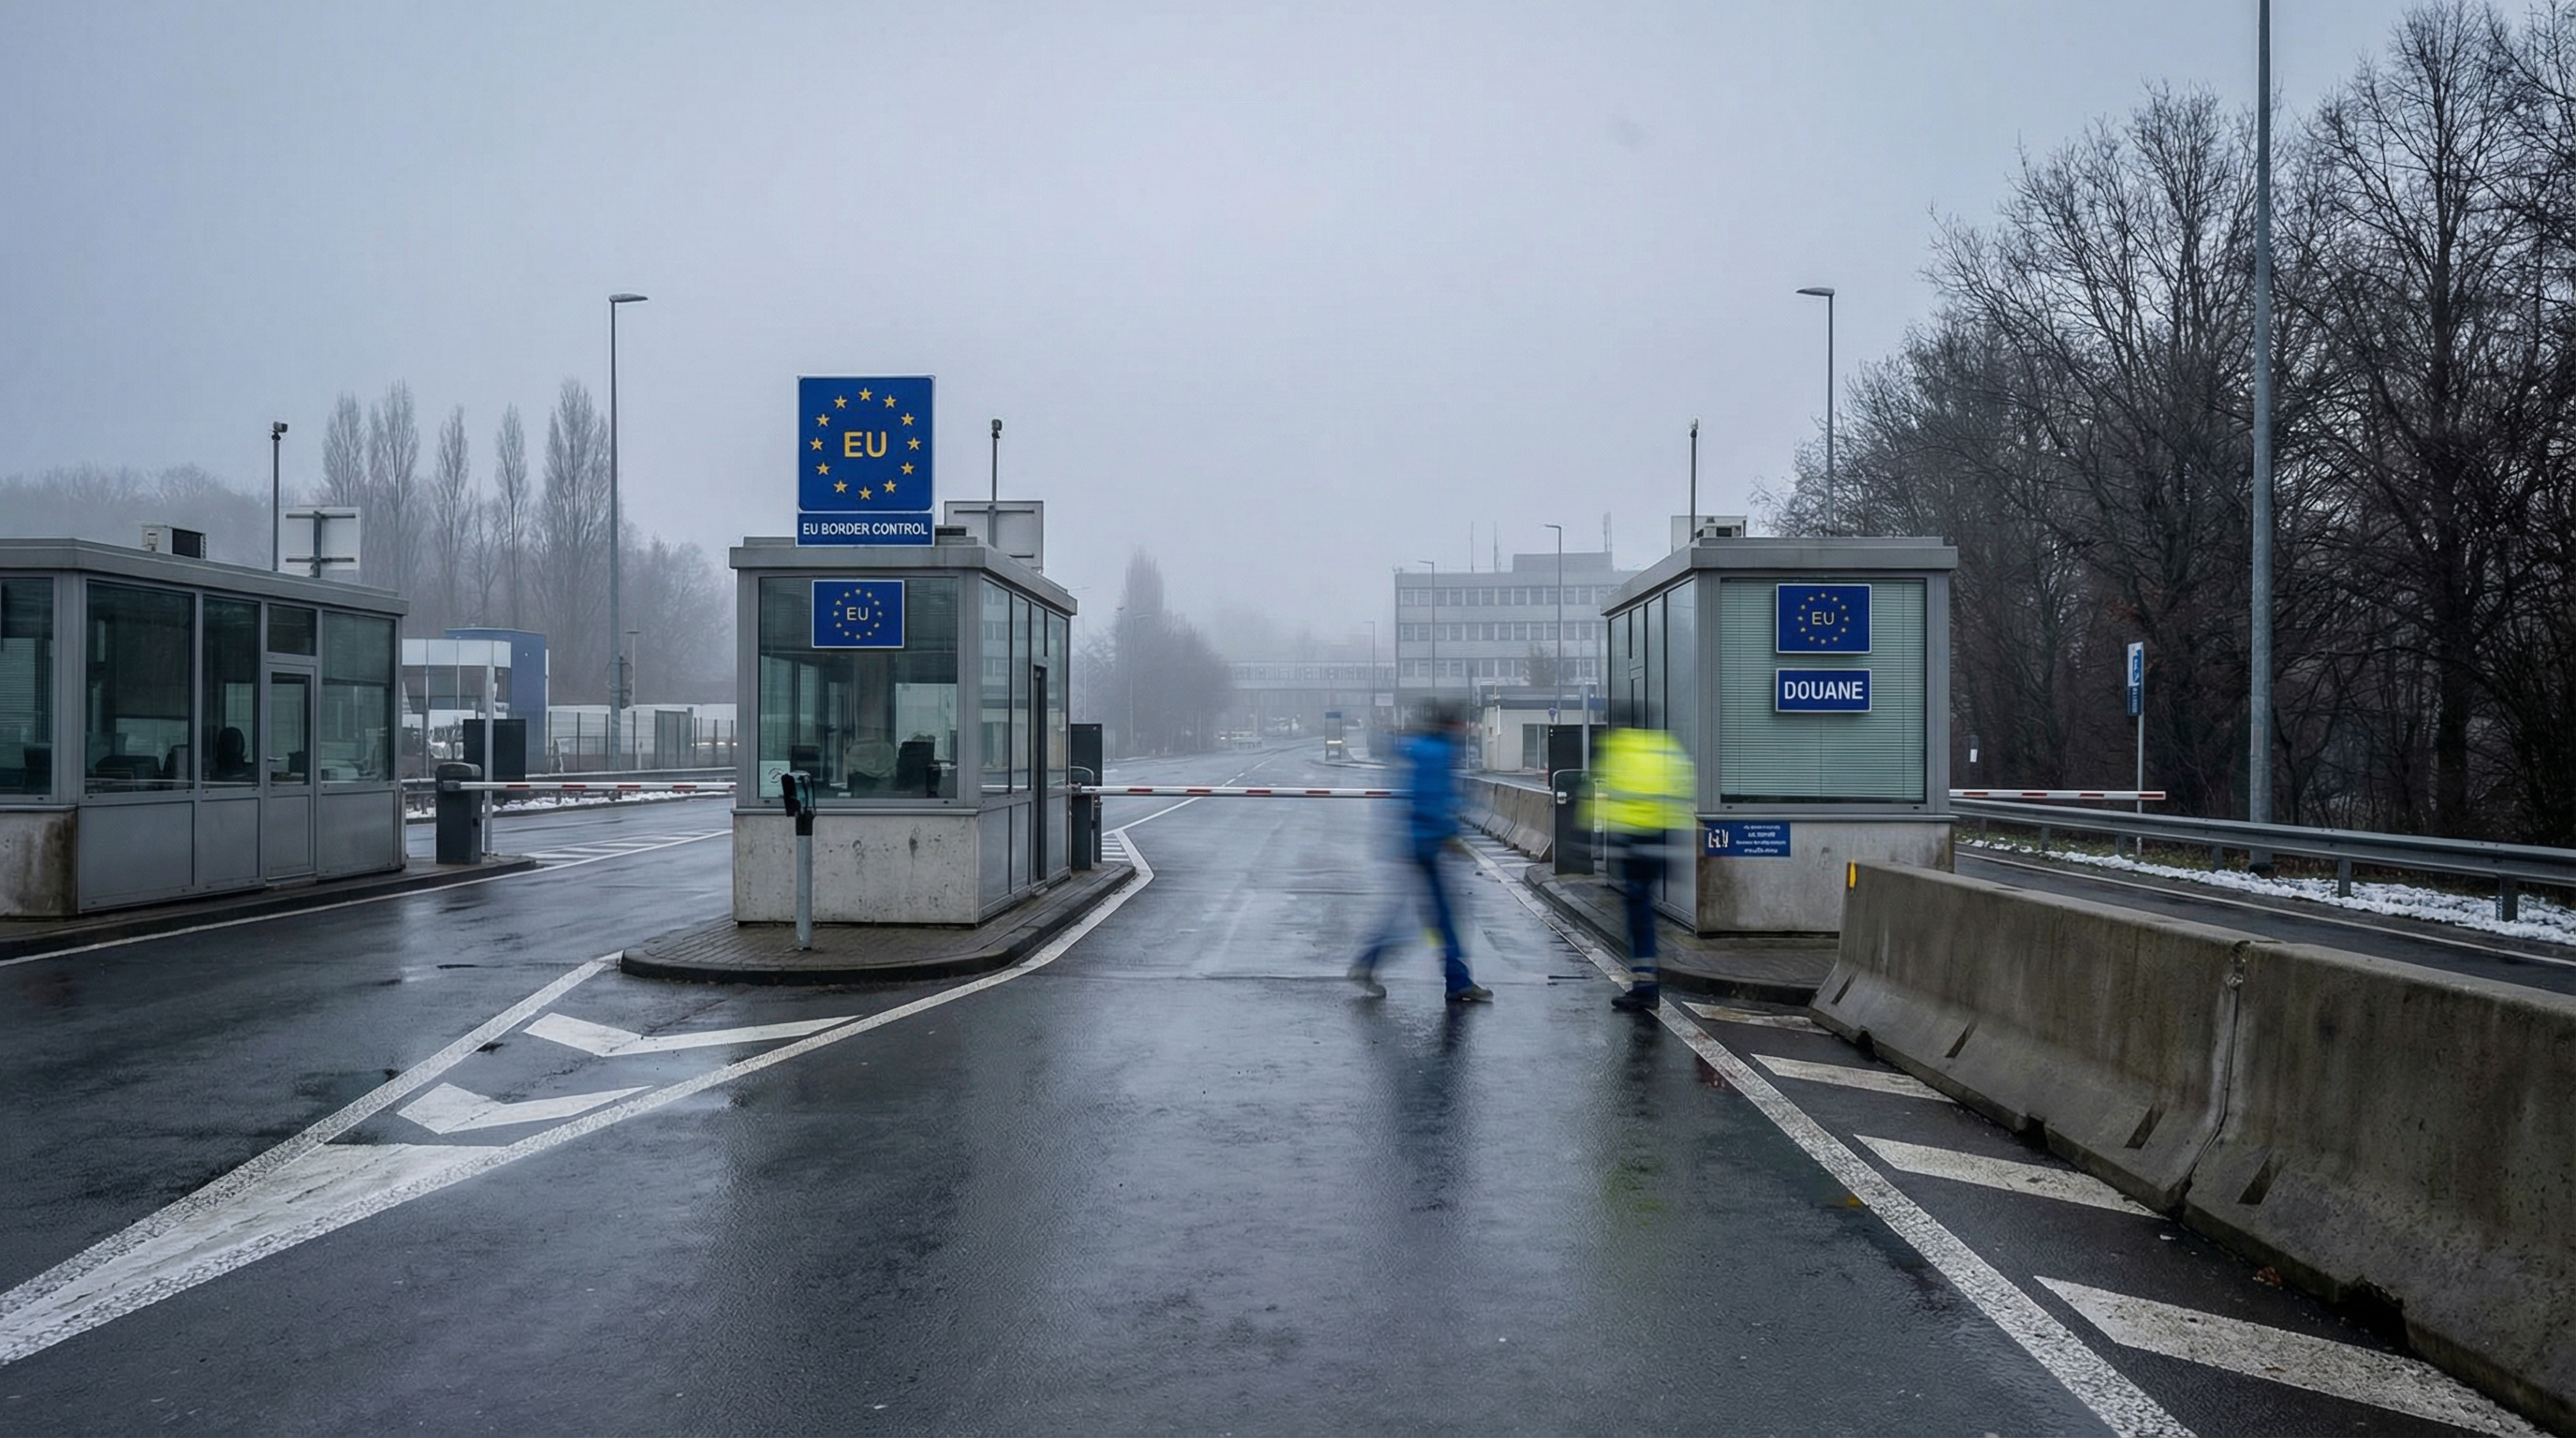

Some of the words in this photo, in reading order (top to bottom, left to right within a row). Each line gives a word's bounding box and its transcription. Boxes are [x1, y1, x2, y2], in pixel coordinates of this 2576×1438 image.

[843, 432, 886, 458] EU
[802, 522, 818, 536] EU
[821, 522, 870, 536] BORDER
[871, 522, 928, 536] CONTROL
[846, 607, 869, 621] EU
[1811, 611, 1835, 625] EU
[1784, 681, 1864, 700] DOUANE
